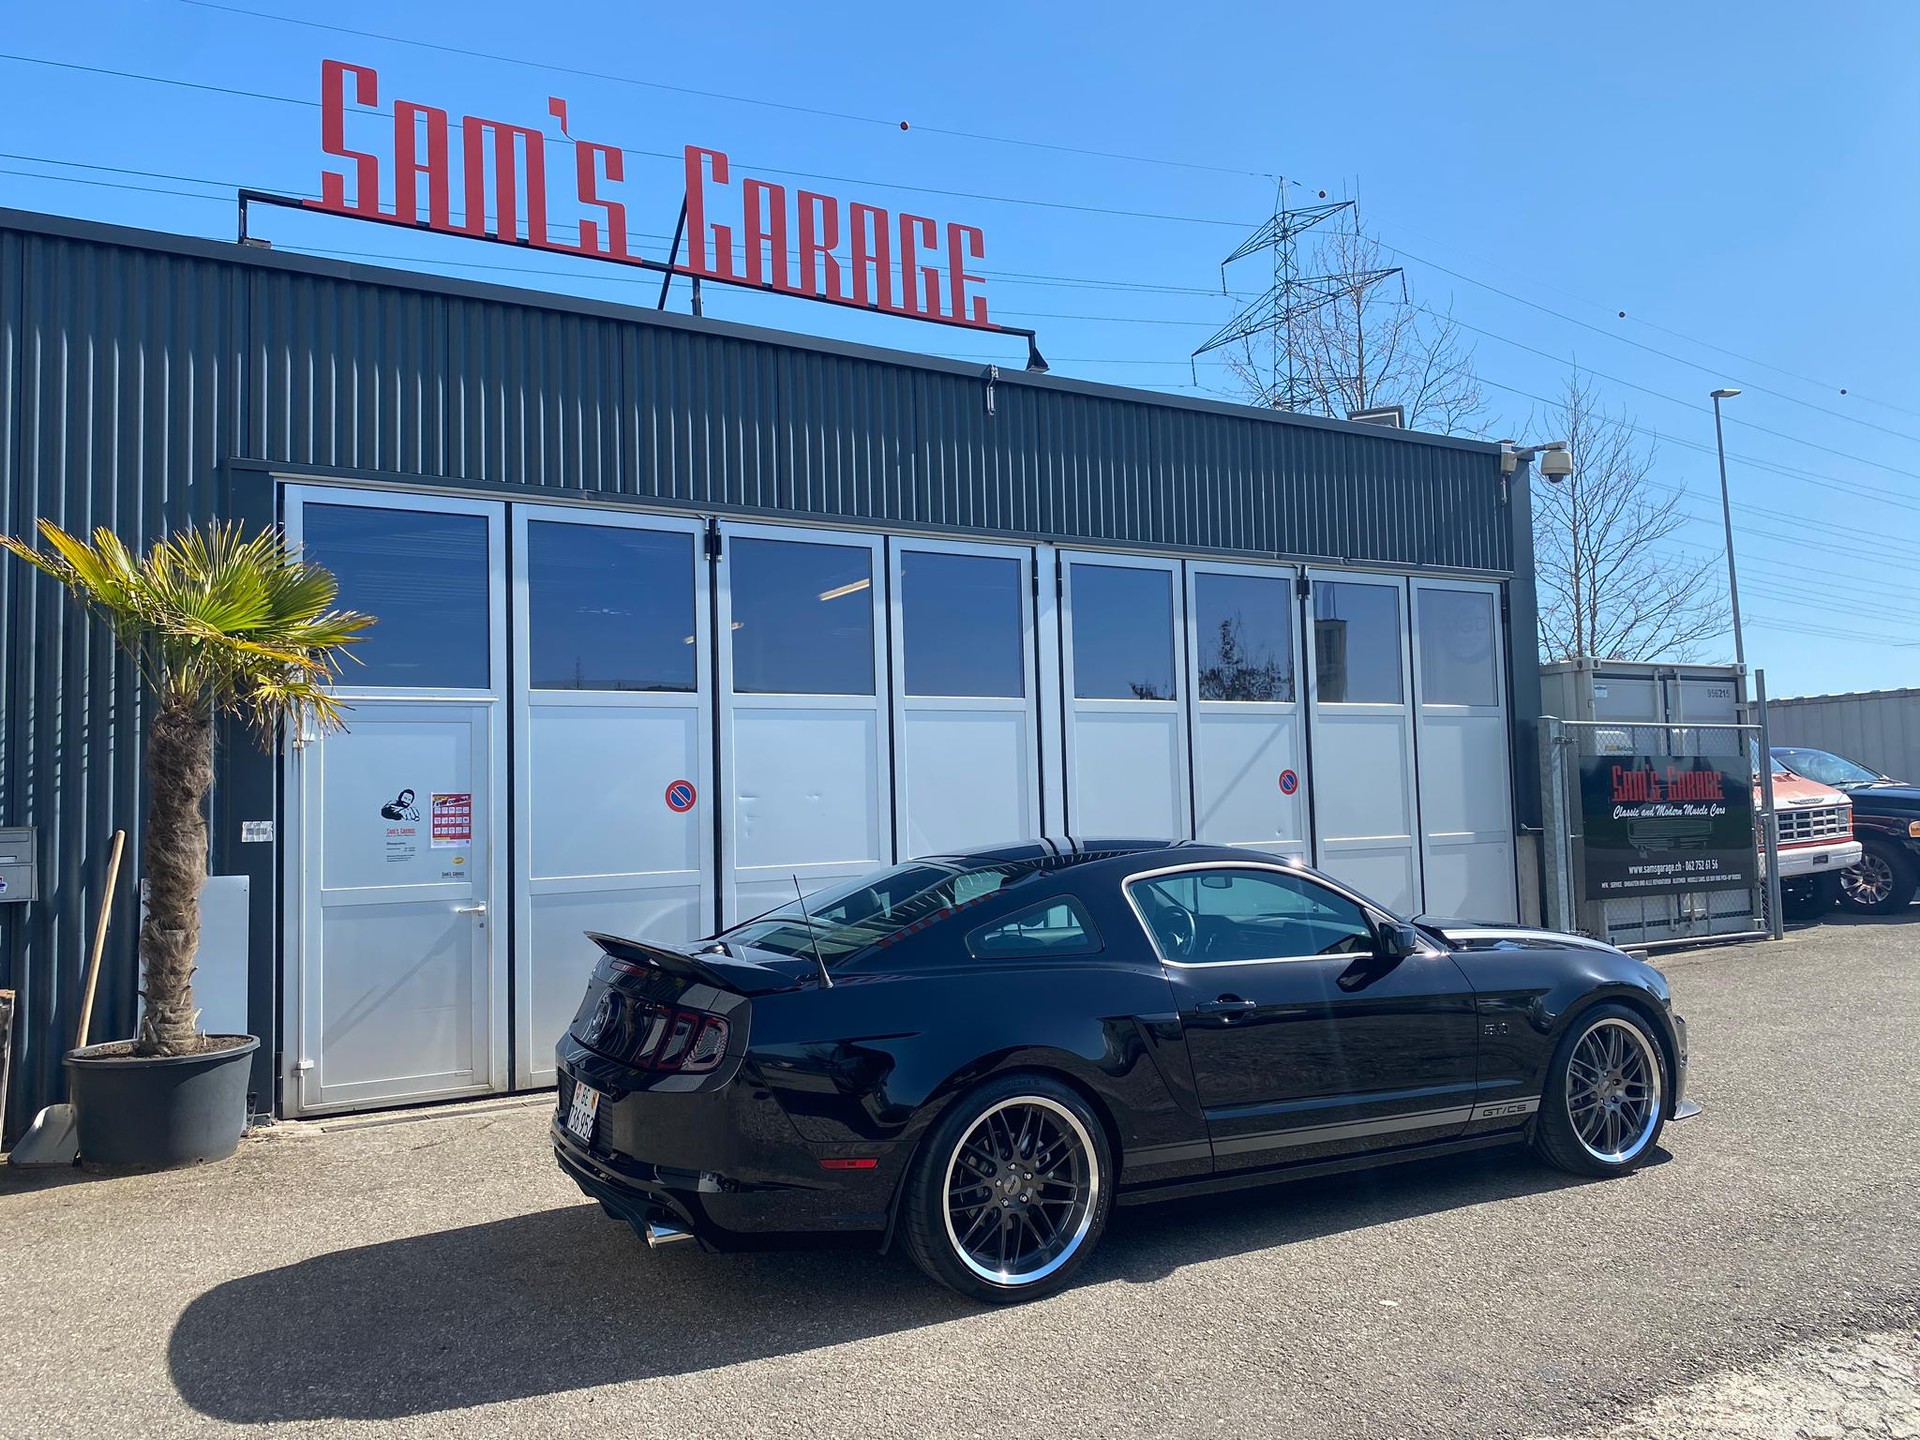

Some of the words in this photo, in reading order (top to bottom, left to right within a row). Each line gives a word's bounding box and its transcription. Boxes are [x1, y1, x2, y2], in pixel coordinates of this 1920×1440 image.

[674, 144, 1001, 331] GARAGE
[1707, 688, 1731, 699] 956215
[1613, 804, 1640, 820] Classic
[1641, 805, 1655, 817] and
[1655, 804, 1683, 817] Modern
[1683, 804, 1708, 816] Muscle
[1709, 803, 1726, 817] Cars
[1628, 861, 1682, 876] www.samsgarage.ch
[1685, 860, 1694, 871] 062
[1695, 860, 1705, 871] 752
[1705, 860, 1711, 870] 61
[1711, 859, 1718, 870] 56
[581, 1087, 590, 1107] BE
[1483, 1104, 1527, 1117] GT/CS
